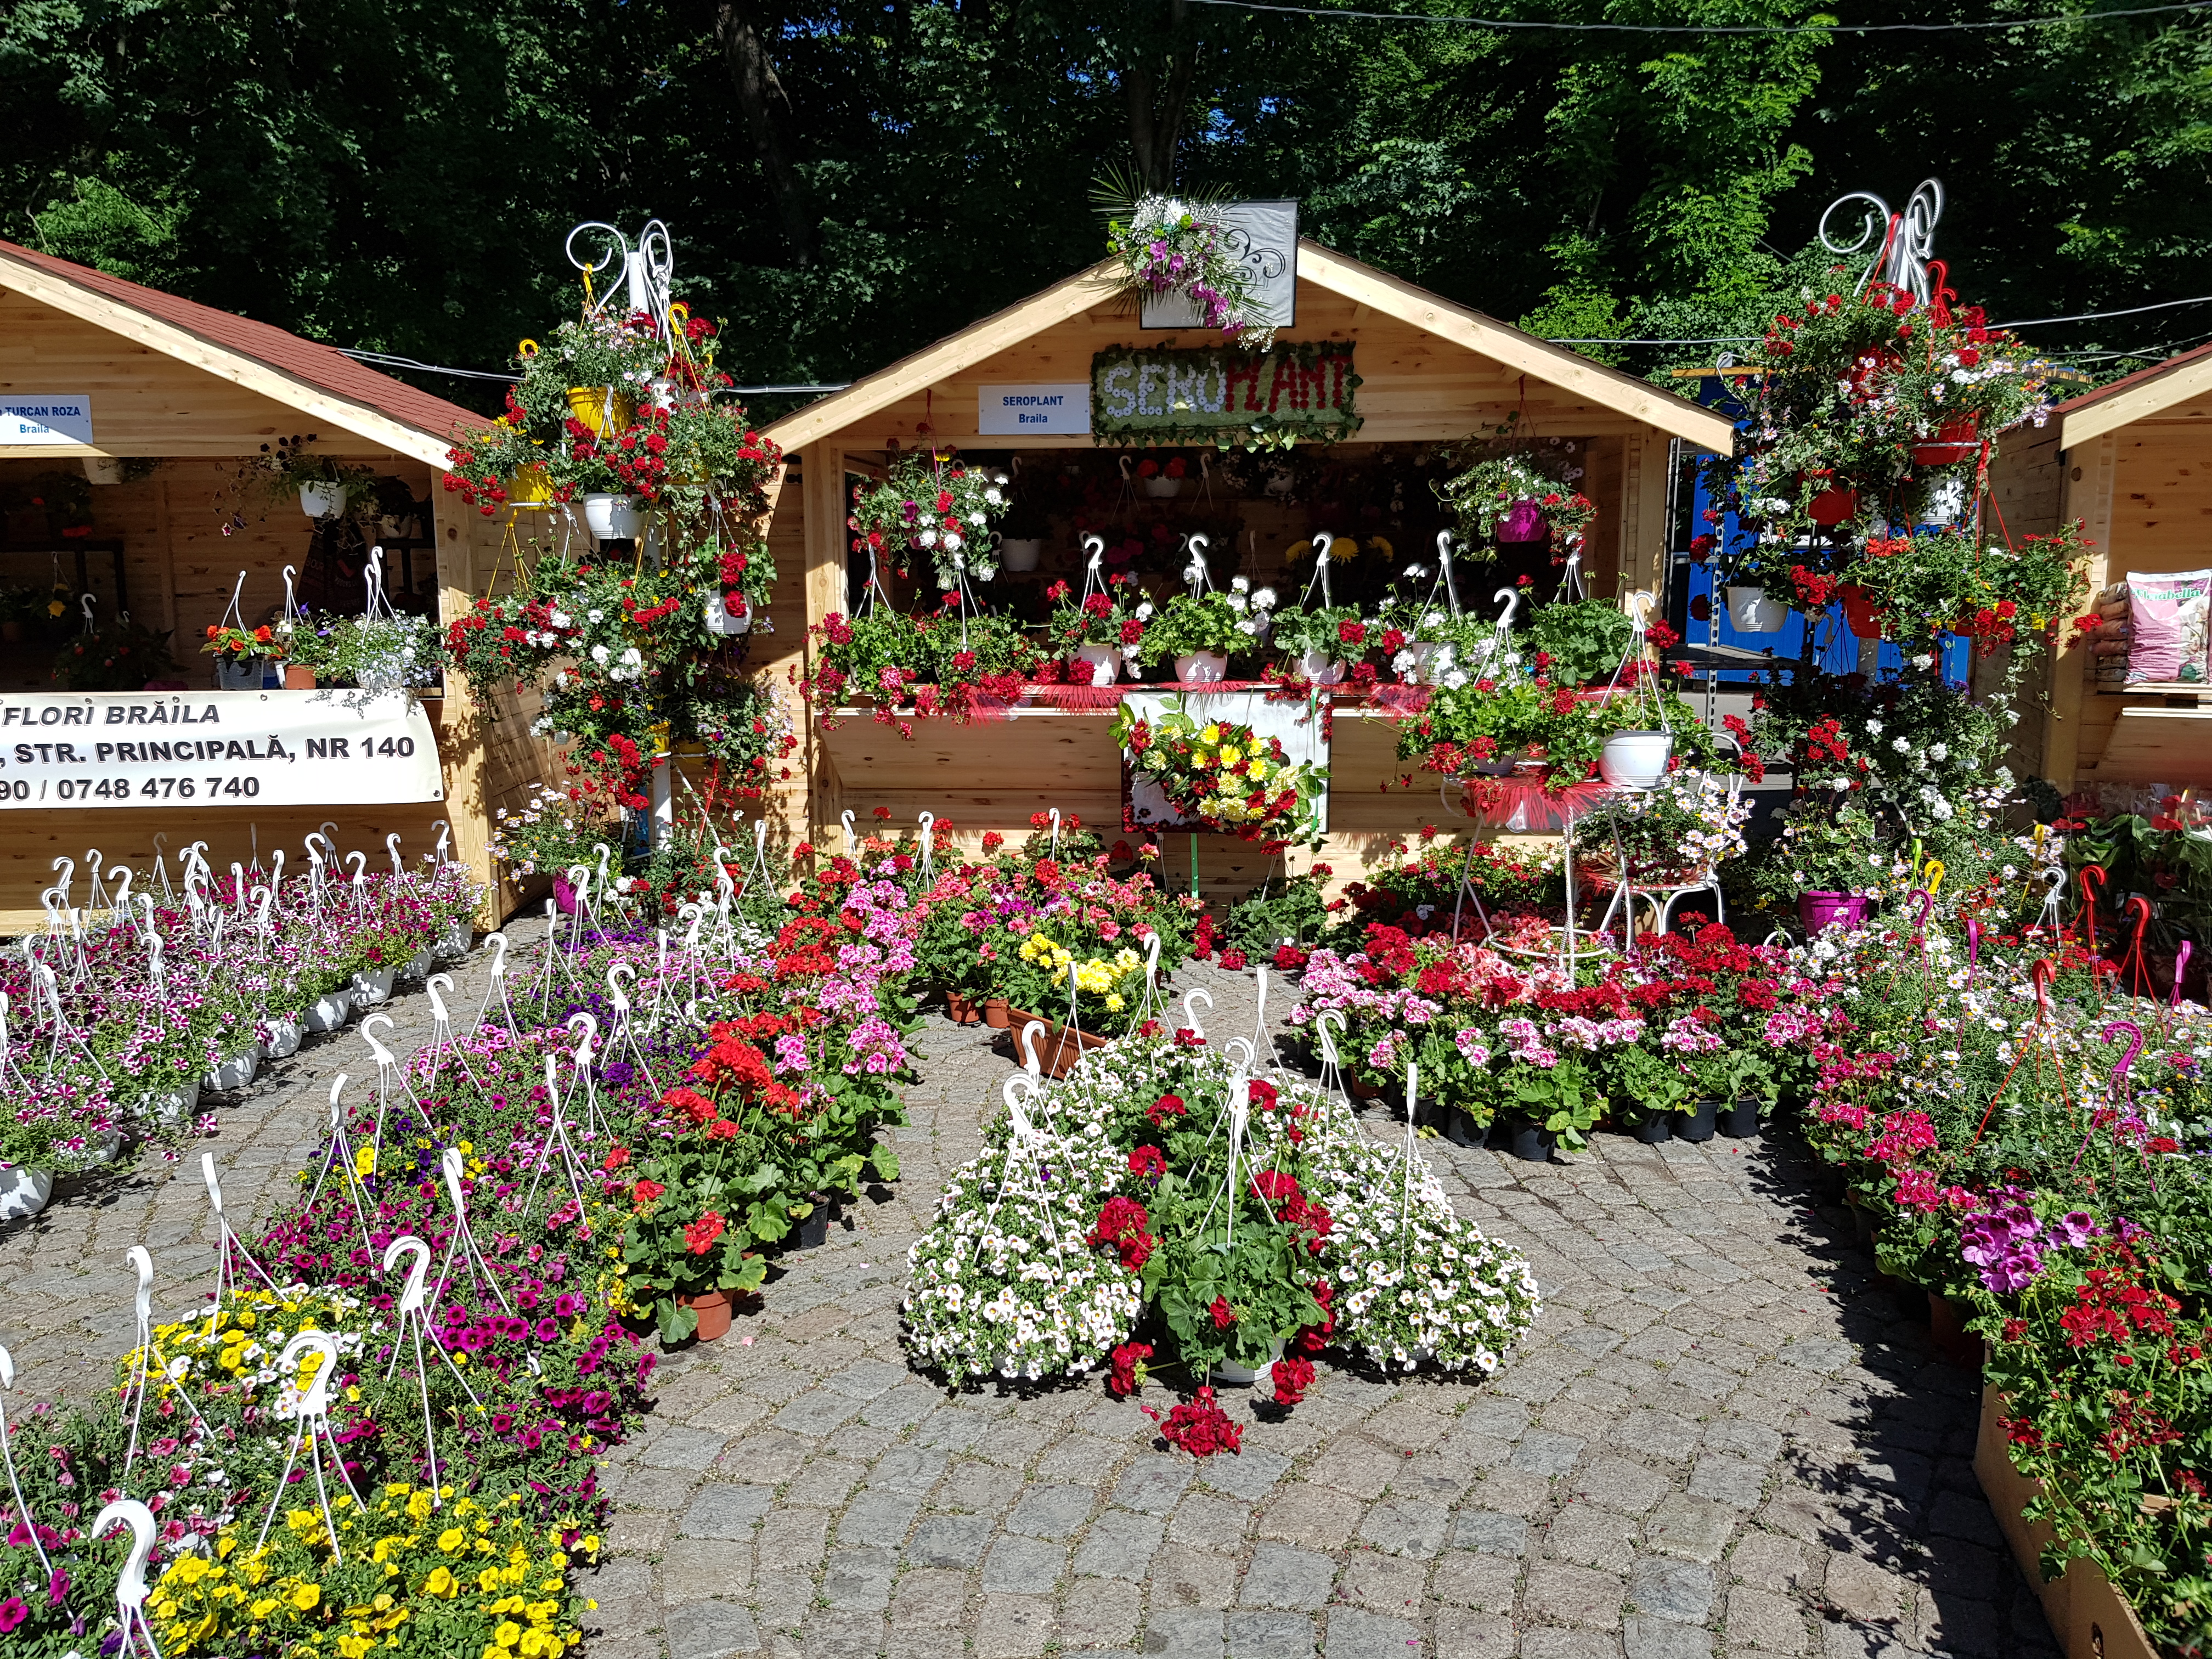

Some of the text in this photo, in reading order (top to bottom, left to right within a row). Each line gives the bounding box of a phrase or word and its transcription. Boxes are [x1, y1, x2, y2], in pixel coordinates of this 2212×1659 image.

[1002, 396, 1064, 407] SEROPLANT
[5, 407, 49, 416] TURCAN
[52, 407, 81, 416] ROZA
[1018, 413, 1048, 424] Braila
[19, 424, 50, 433] Braila
[2, 701, 221, 726] FLORI BRĂILA
[14, 743, 87, 764] STR.
[94, 735, 295, 763] PRINCIPALĂ,
[305, 738, 350, 759] NR
[360, 737, 415, 758] 140
[40, 779, 48, 801] /
[57, 778, 131, 800] 0748
[140, 777, 196, 799] 476
[205, 776, 260, 798] 740
